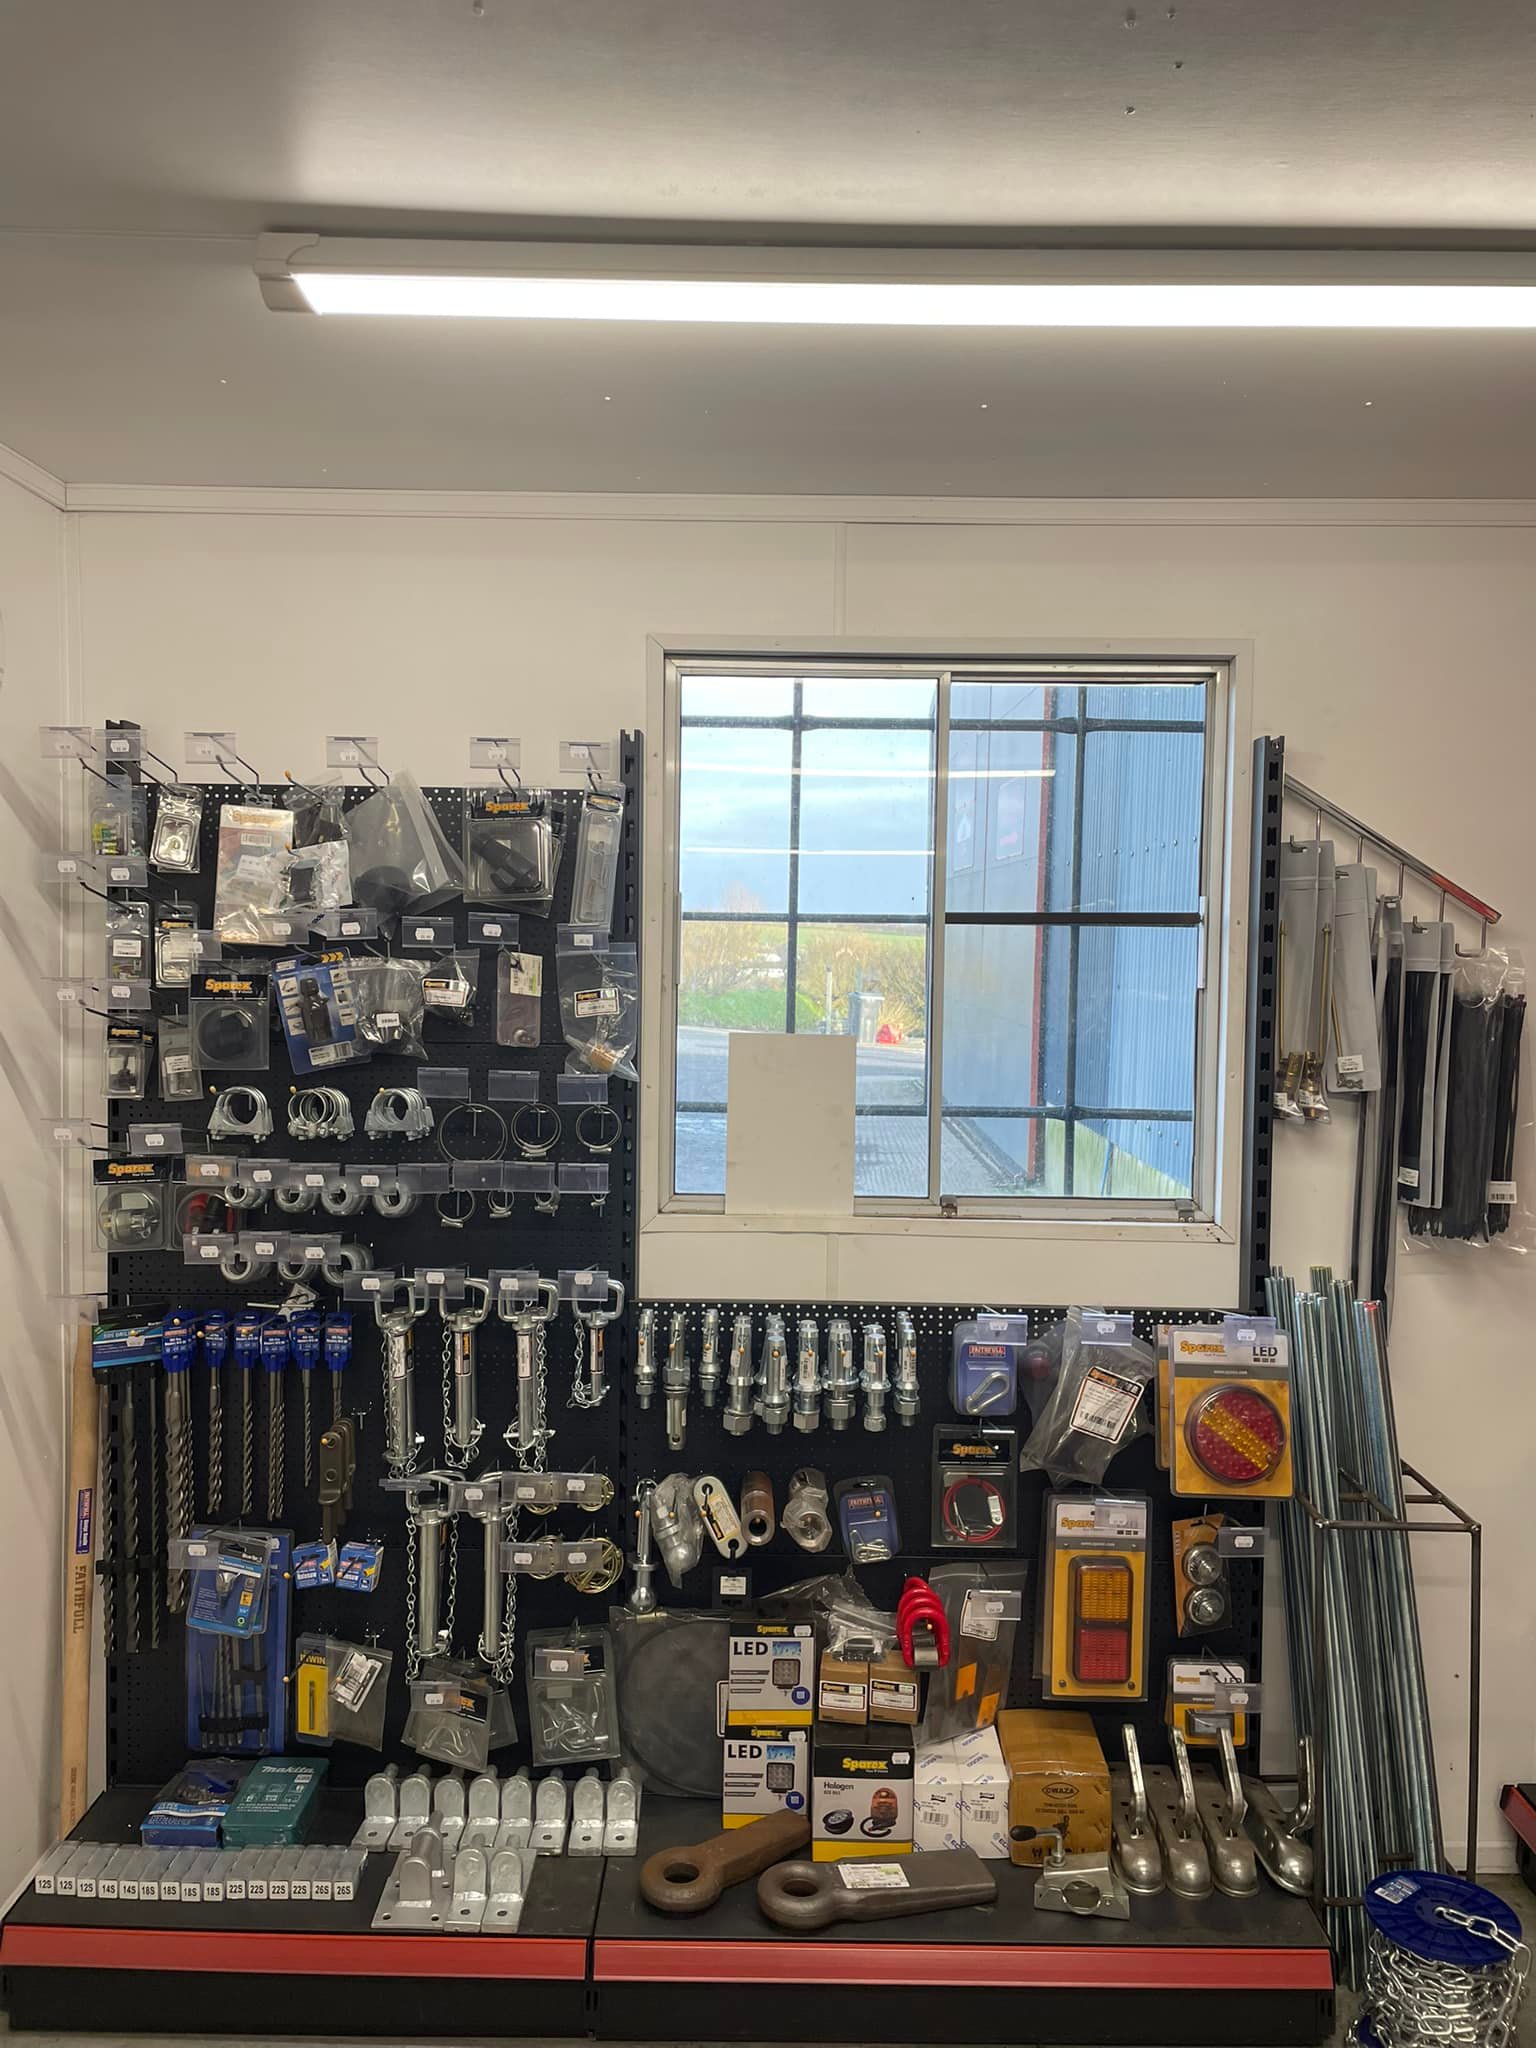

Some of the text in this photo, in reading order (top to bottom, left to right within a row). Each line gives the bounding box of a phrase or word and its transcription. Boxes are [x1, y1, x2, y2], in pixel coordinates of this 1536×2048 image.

[205, 978, 252, 992] Sparex
[108, 1162, 155, 1177] Sparex
[1180, 1340, 1225, 1355] Sparex
[1252, 1346, 1278, 1358] LED
[73, 1565, 87, 1634] FAITHFULL
[733, 1641, 768, 1656] LED
[727, 1743, 762, 1759] LED
[842, 1757, 888, 1772] Sparex
[823, 1781, 854, 1791] Halogen
[38, 1879, 52, 1889] 12S
[59, 1880, 73, 1890] 12S
[80, 1882, 93, 1893] 12S
[102, 1884, 115, 1894] 14S
[229, 1884, 242, 1894] 22S
[123, 1885, 136, 1894] 14S
[142, 1886, 155, 1896] 18S
[163, 1885, 177, 1895] 18S
[184, 1888, 197, 1897] 18S
[207, 1887, 219, 1896] 18S
[250, 1885, 263, 1895] 22S
[272, 1885, 285, 1895] 22S
[293, 1885, 306, 1895] 22S
[315, 1885, 329, 1895] 26S
[337, 1885, 351, 1895] 26S
